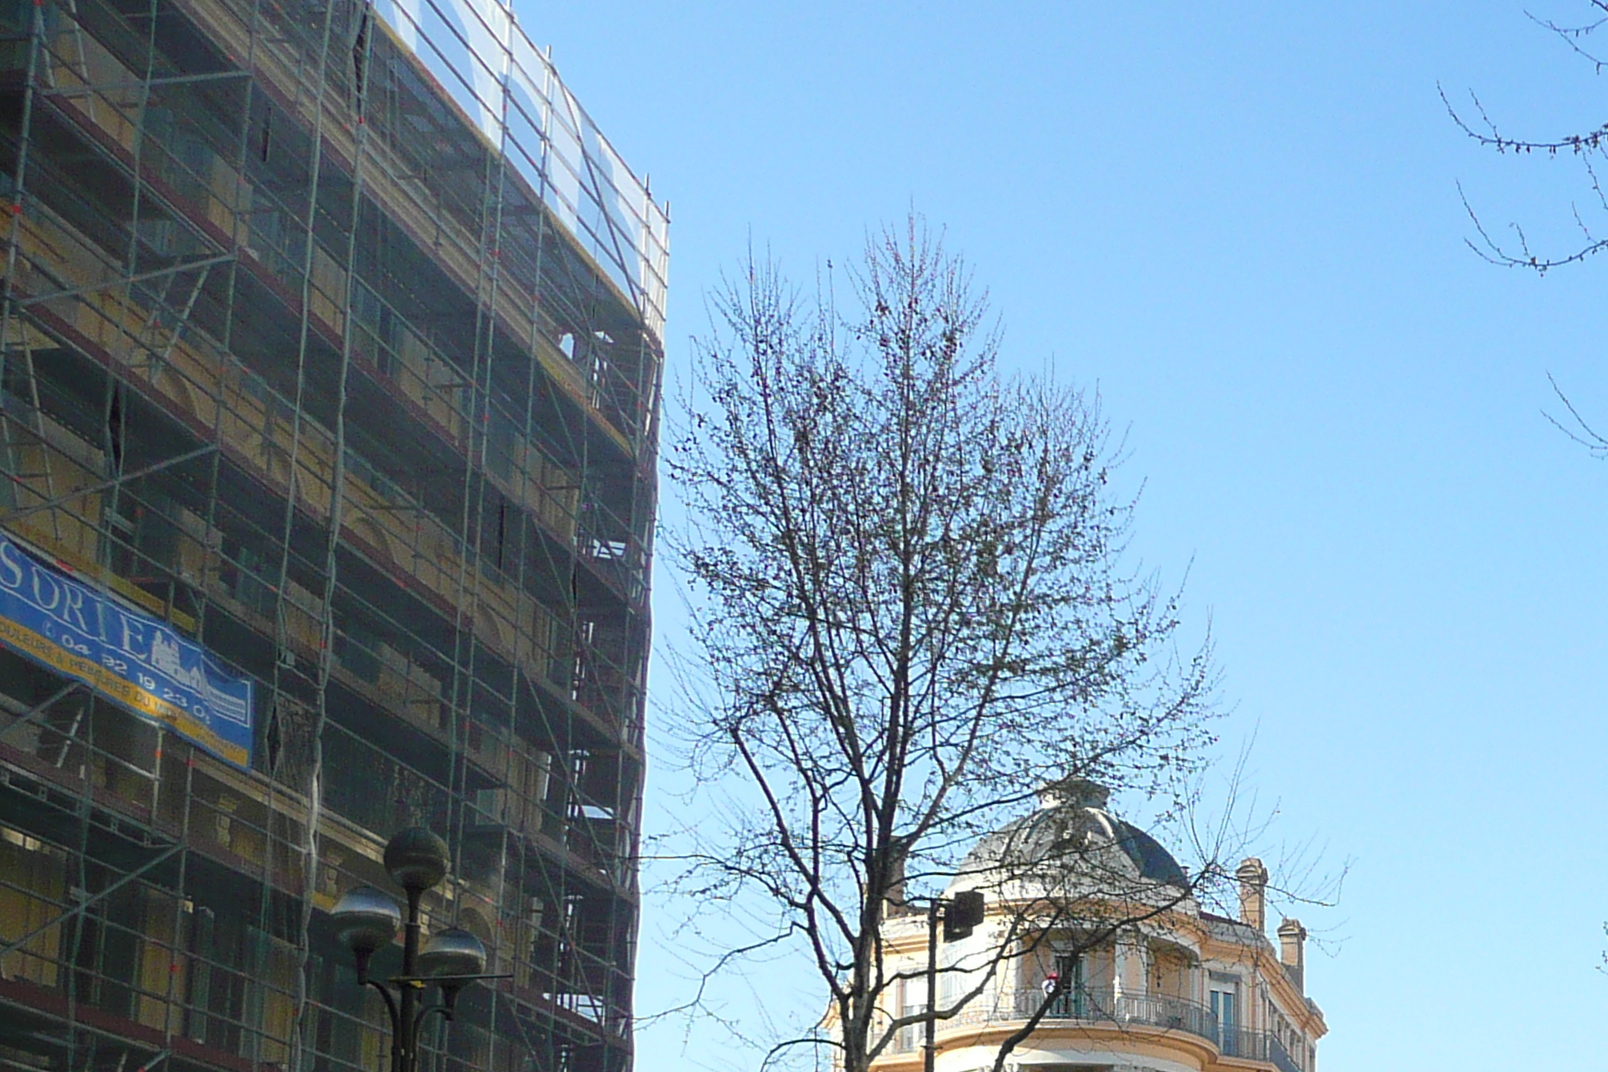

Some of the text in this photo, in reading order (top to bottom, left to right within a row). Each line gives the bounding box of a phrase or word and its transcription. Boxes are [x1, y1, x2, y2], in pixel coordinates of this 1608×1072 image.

[62, 634, 92, 655] 04
[136, 672, 155, 690] 19
[162, 688, 188, 707] 23
